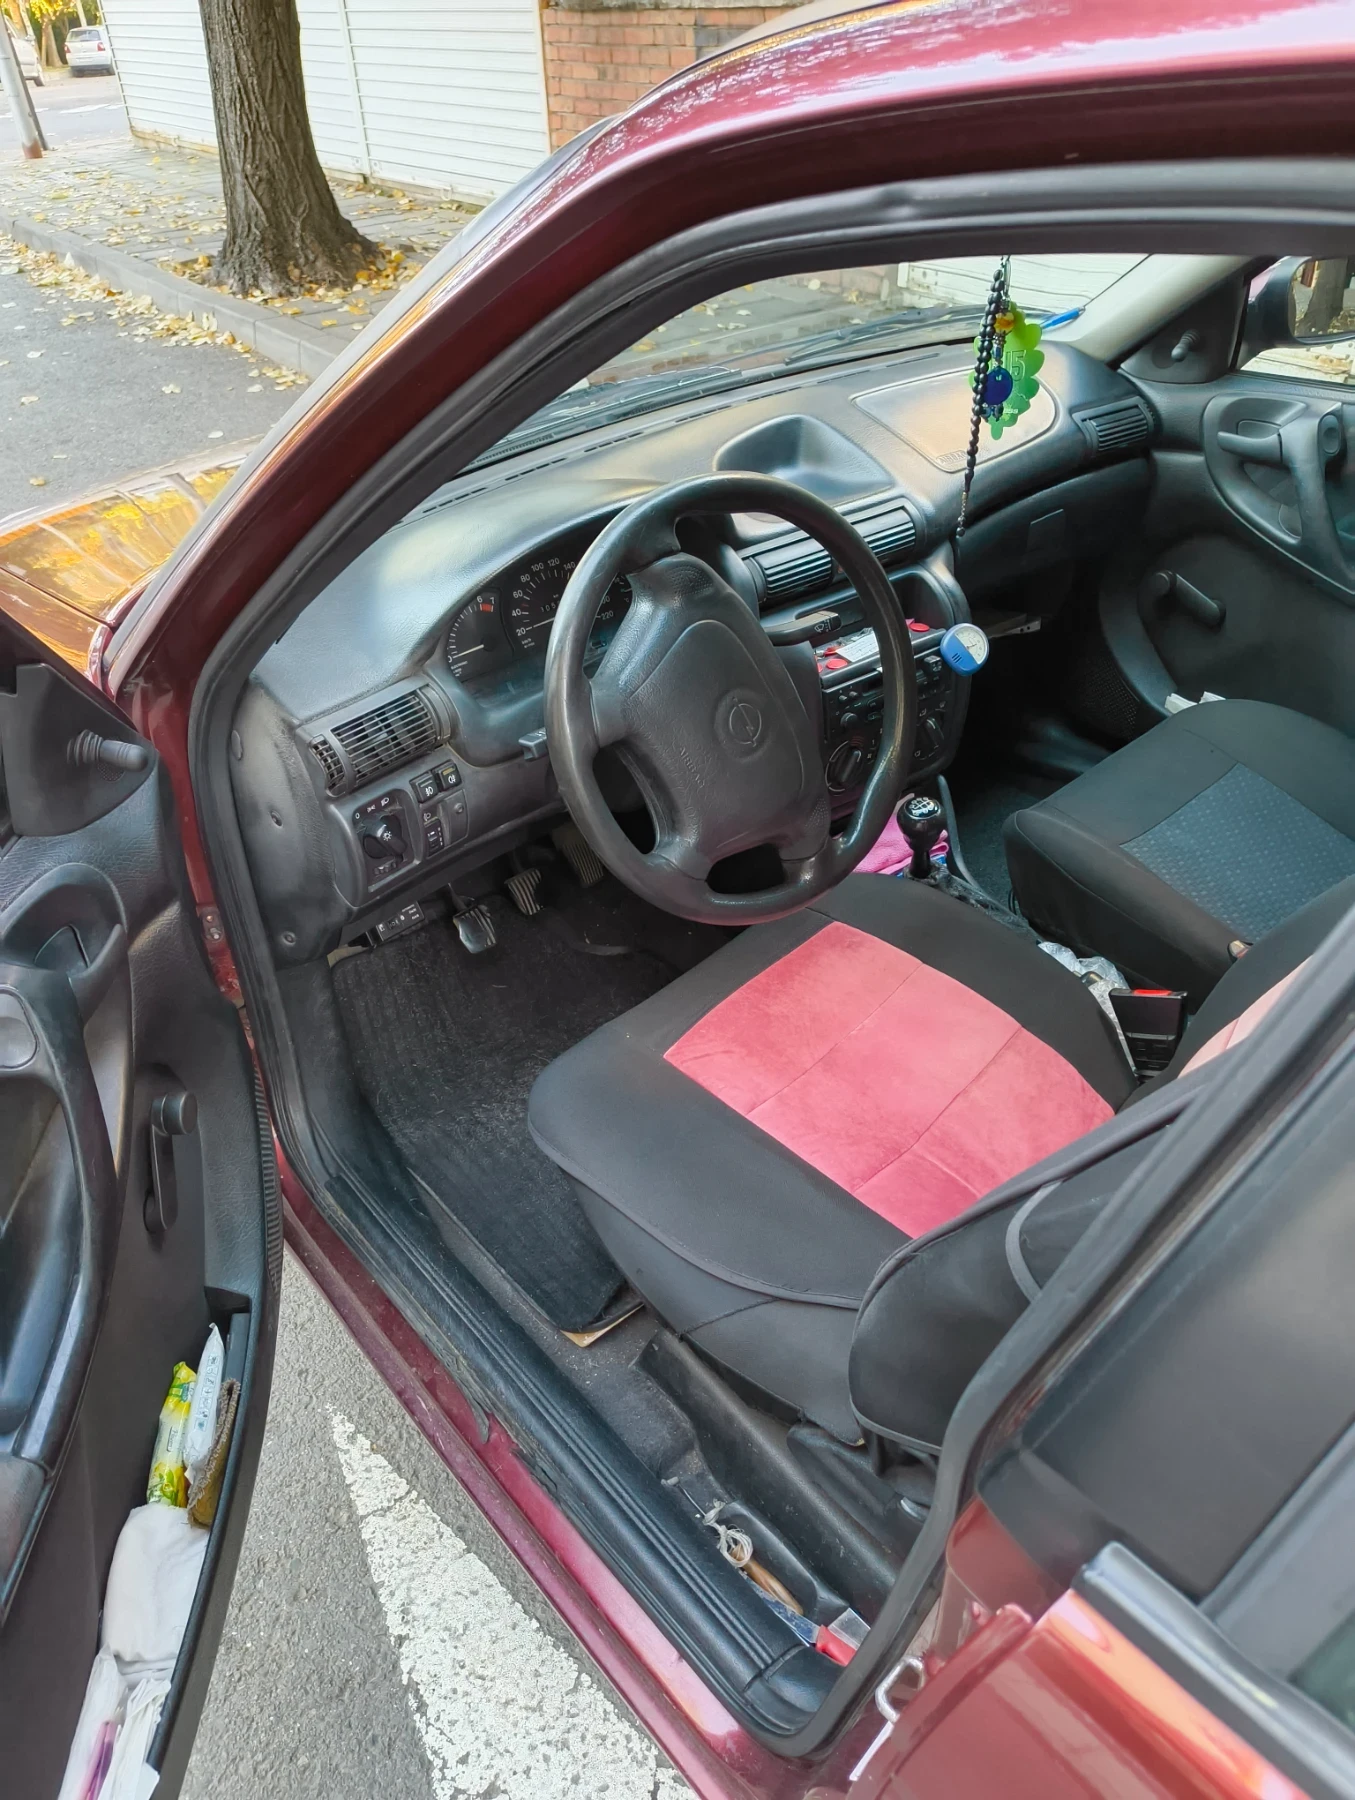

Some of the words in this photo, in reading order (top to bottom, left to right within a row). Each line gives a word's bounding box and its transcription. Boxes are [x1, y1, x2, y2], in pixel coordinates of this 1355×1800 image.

[547, 557, 560, 567] 120
[563, 561, 576, 570] 140
[531, 562, 544, 572] 100
[520, 574, 531, 583] 80
[513, 590, 523, 598] 60
[477, 595, 483, 603] 6
[512, 608, 521, 617] 40
[601, 610, 614, 620] 220
[516, 627, 526, 636] 20
